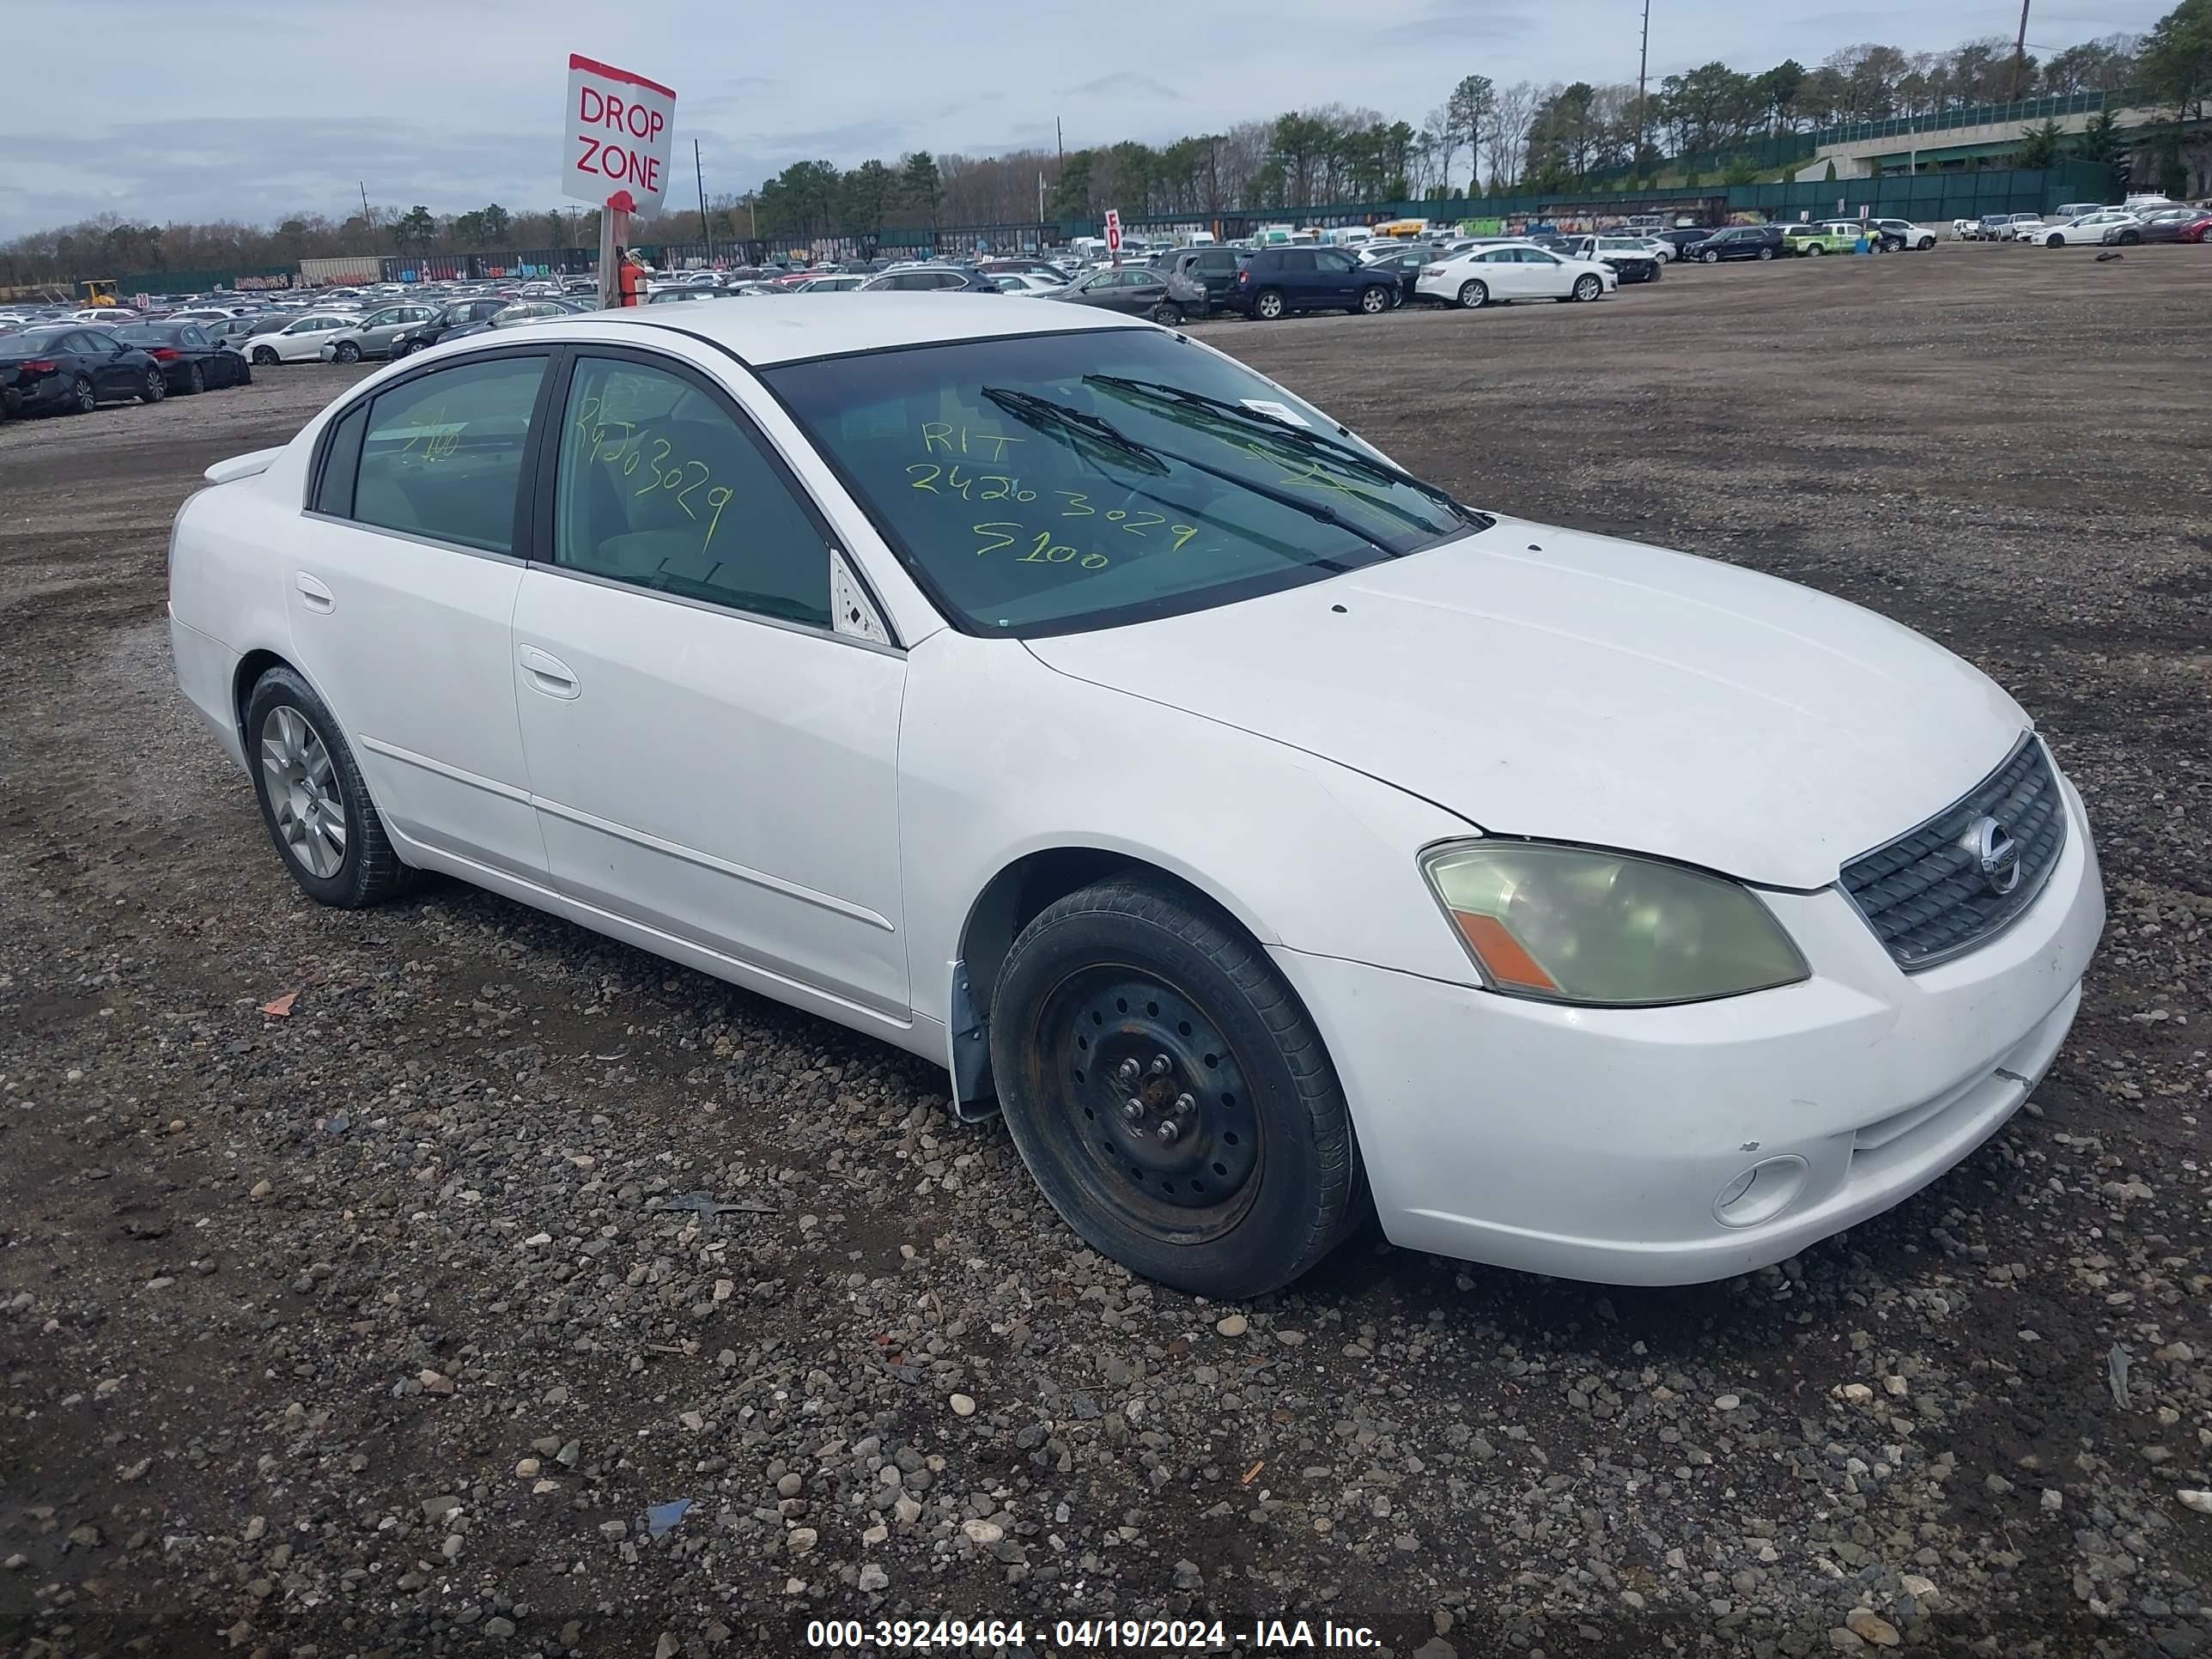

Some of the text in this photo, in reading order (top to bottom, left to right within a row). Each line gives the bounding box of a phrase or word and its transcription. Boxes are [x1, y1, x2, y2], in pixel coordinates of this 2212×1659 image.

[580, 86, 664, 143] DROP
[576, 135, 660, 192] ZONE
[1109, 228, 1119, 250] D
[137, 295, 148, 307] 20
[921, 422, 1027, 463] RIT
[972, 521, 1109, 569] S100
